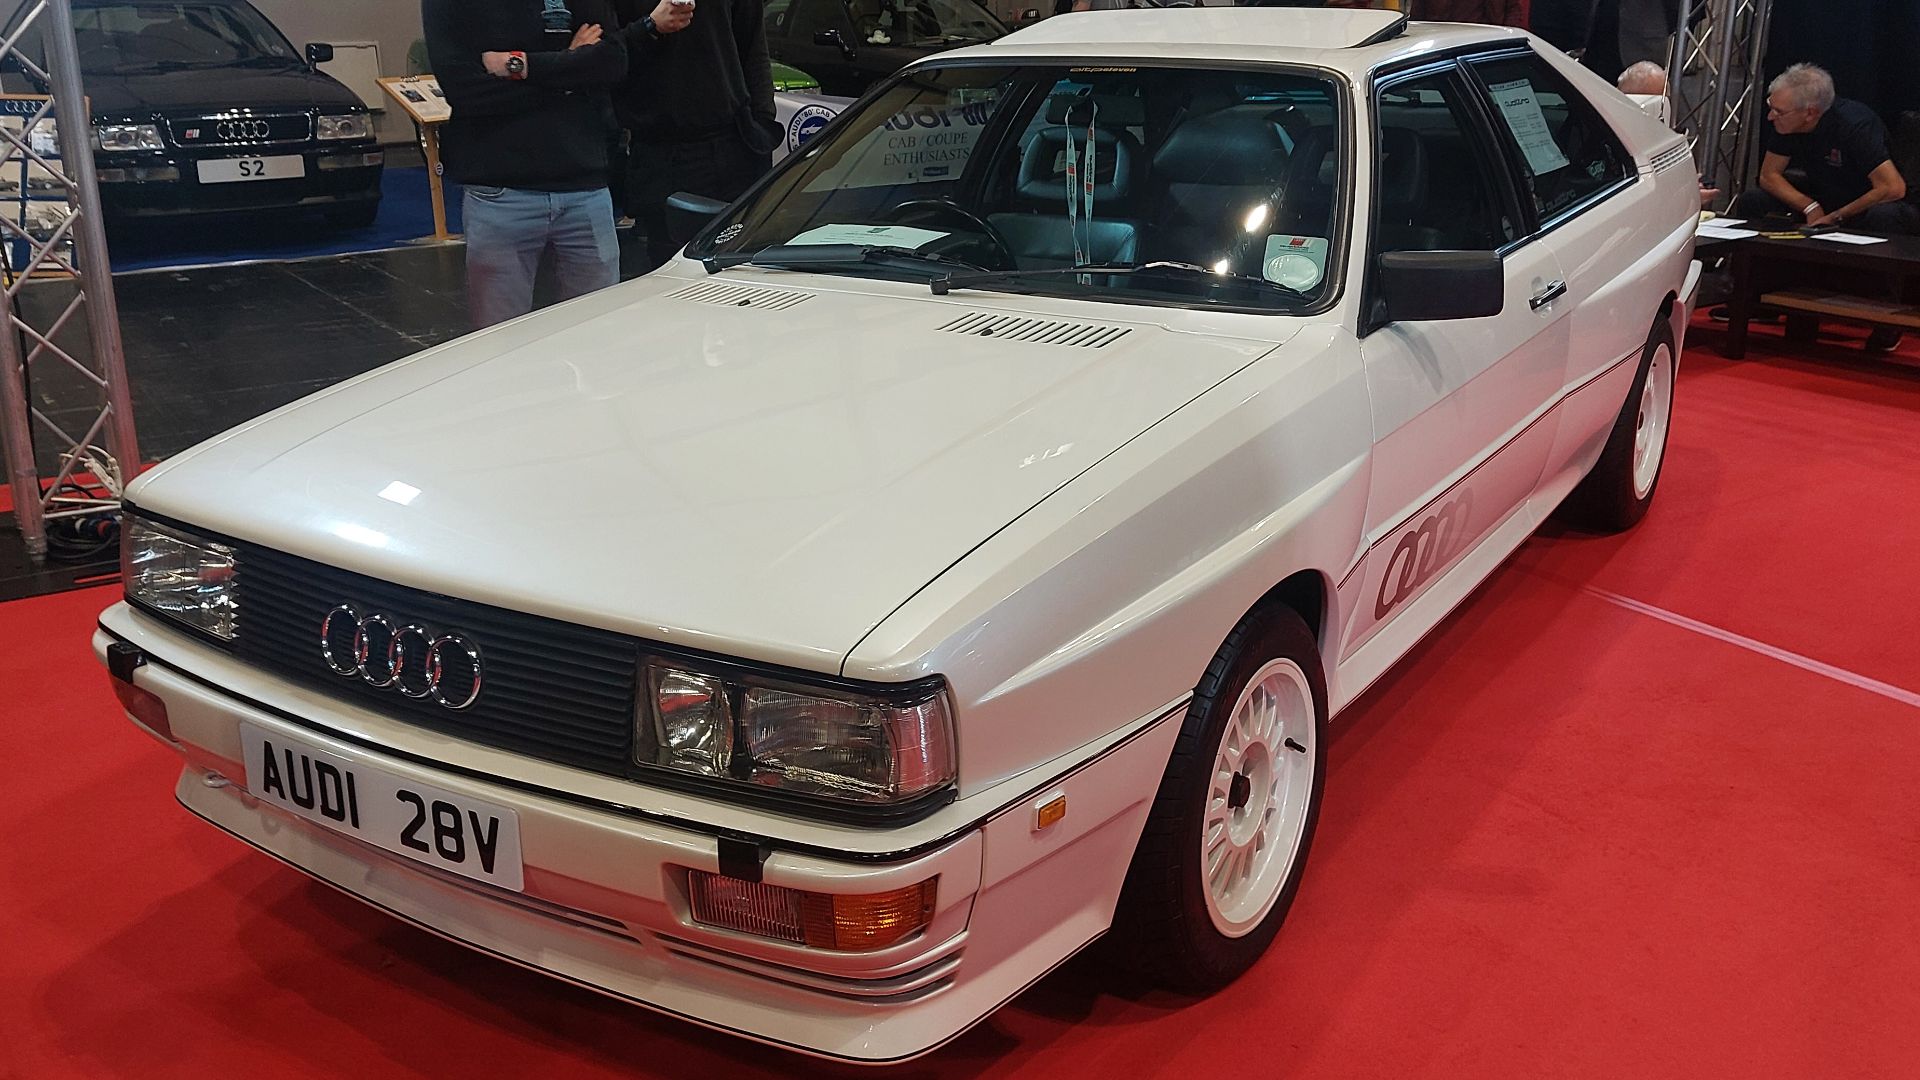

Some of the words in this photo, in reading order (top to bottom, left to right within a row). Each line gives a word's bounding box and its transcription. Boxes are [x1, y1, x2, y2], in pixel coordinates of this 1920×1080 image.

[1504, 96, 1530, 108] quattro
[791, 116, 803, 137] AUDI
[815, 108, 831, 118] CAB
[888, 136, 916, 149] CAB
[926, 131, 969, 147] COUPE
[884, 148, 970, 166] ENTHUSIASTS
[263, 740, 360, 829] AUDI
[395, 789, 499, 875] 28V
